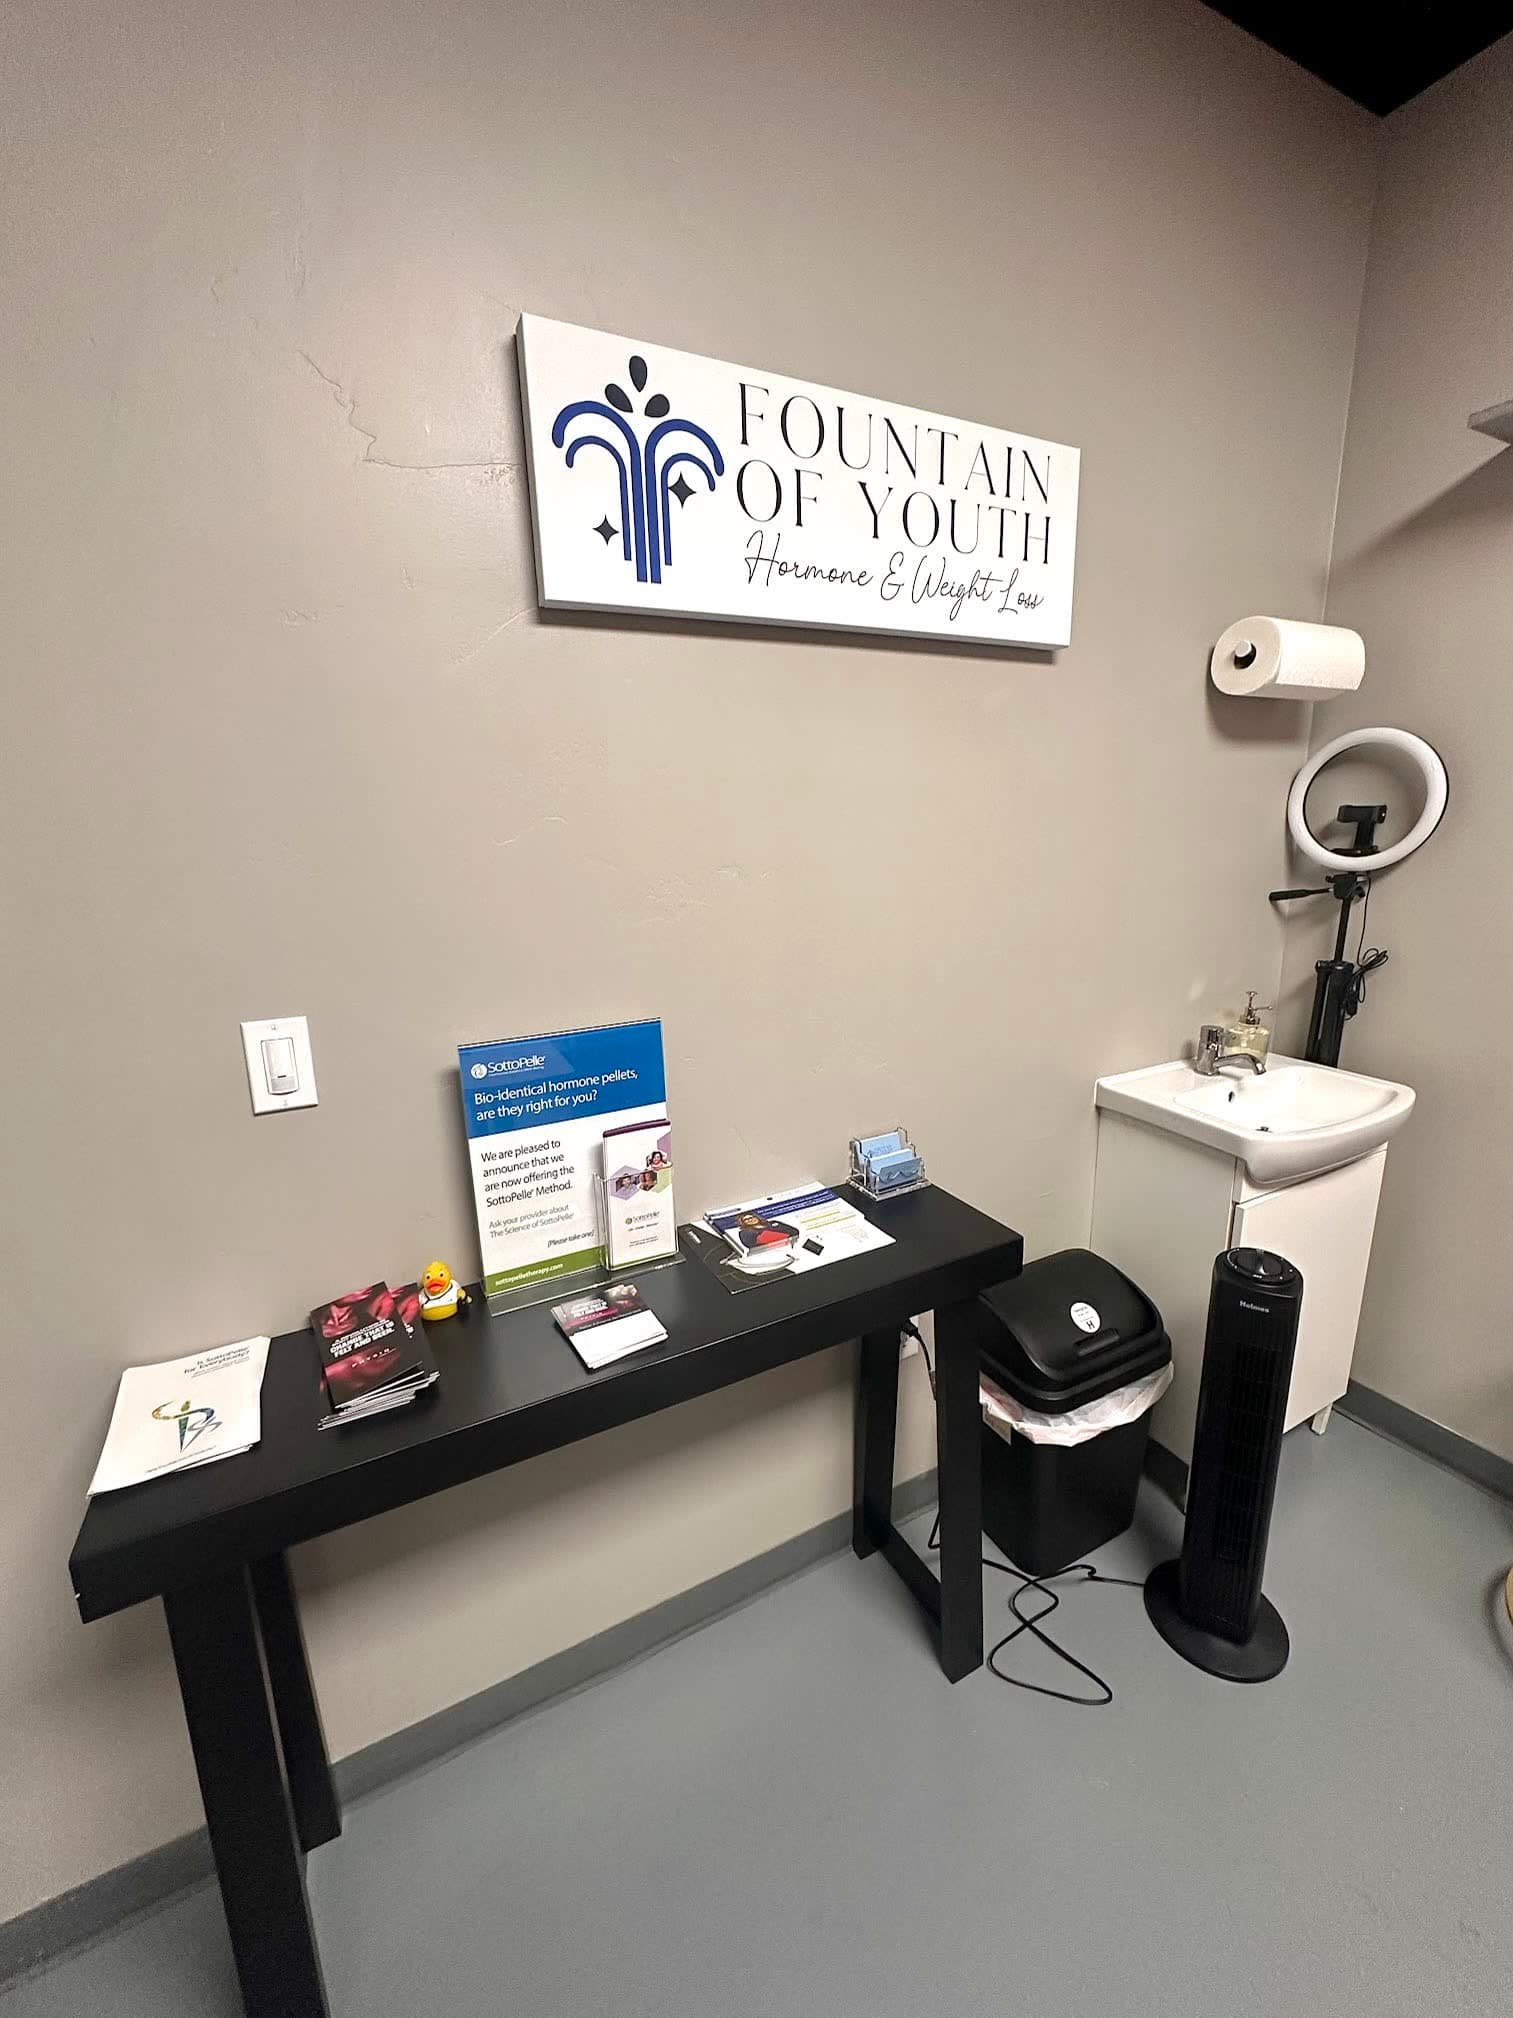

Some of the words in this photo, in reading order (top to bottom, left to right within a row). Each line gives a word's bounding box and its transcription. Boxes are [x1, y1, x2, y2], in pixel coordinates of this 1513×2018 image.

[738, 382, 1051, 504] FOUNTAIN
[736, 459, 823, 528] OF
[858, 480, 1051, 565] YOUTH
[744, 530, 874, 587] Hormone
[880, 551, 905, 601] &
[912, 555, 1003, 621] Weight
[997, 567, 1045, 614] Loss
[474, 1082, 546, 1105] Bio-identical
[549, 1074, 599, 1092] hormone
[601, 1069, 638, 1086] pellets,
[476, 1108, 495, 1121] are
[497, 1103, 524, 1118] they
[526, 1098, 553, 1114] right
[554, 1095, 570, 1107] for
[571, 1089, 598, 1106] you?
[481, 1152, 497, 1162] We
[498, 1149, 513, 1160] are
[515, 1140, 549, 1158] pleased
[551, 1140, 561, 1148] to
[483, 1160, 530, 1177] announce
[531, 1156, 549, 1168] that
[551, 1153, 564, 1163] we
[484, 1182, 499, 1192] are
[501, 1177, 522, 1189] now
[523, 1169, 558, 1184] offering
[559, 1165, 575, 1175] the
[535, 1180, 573, 1196] Method.
[489, 1220, 502, 1229] Ask
[502, 1216, 518, 1226] your
[520, 1209, 548, 1223] provider
[549, 1204, 569, 1215] about
[490, 1229, 504, 1239] The
[504, 1223, 531, 1235] Science
[531, 1219, 539, 1228] of
